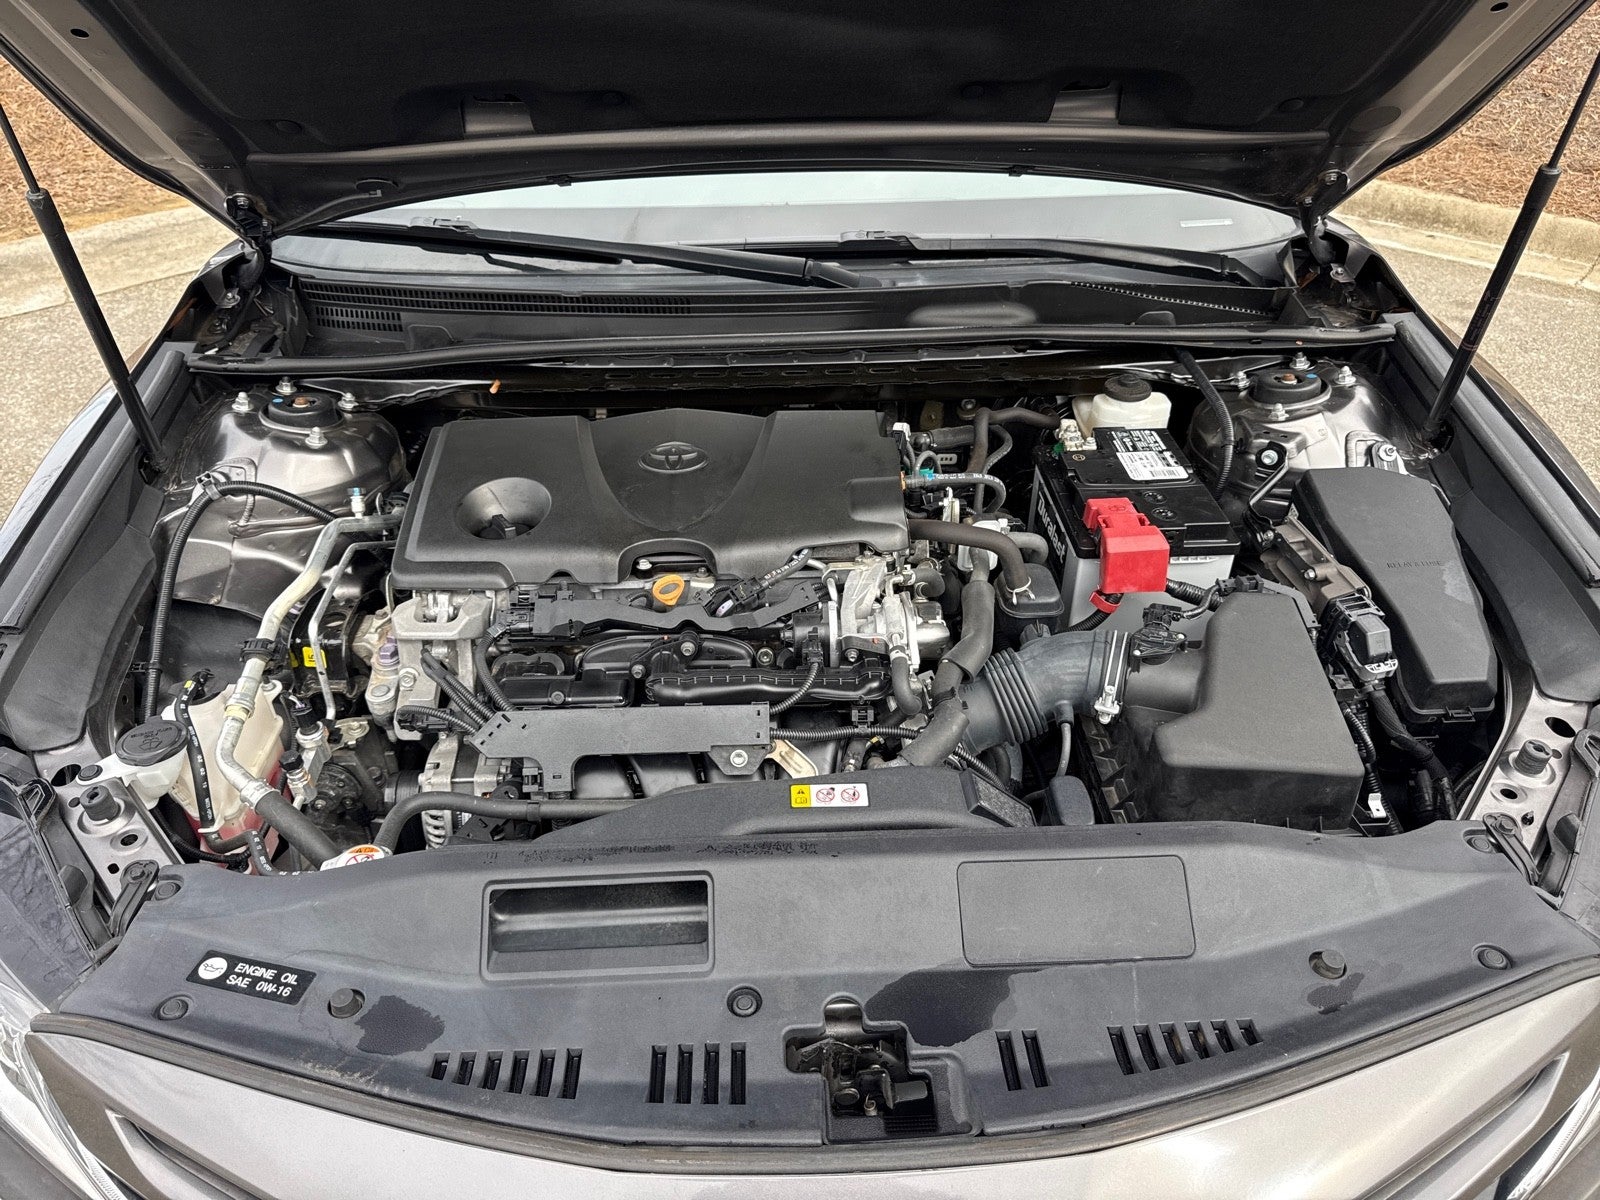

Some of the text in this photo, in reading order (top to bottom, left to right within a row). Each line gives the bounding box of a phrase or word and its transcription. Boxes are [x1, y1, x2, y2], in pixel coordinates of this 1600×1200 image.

[1038, 490, 1066, 564] Duralast
[234, 962, 298, 985] ENGINE OIL
[226, 974, 292, 997] SAE 0W-16
